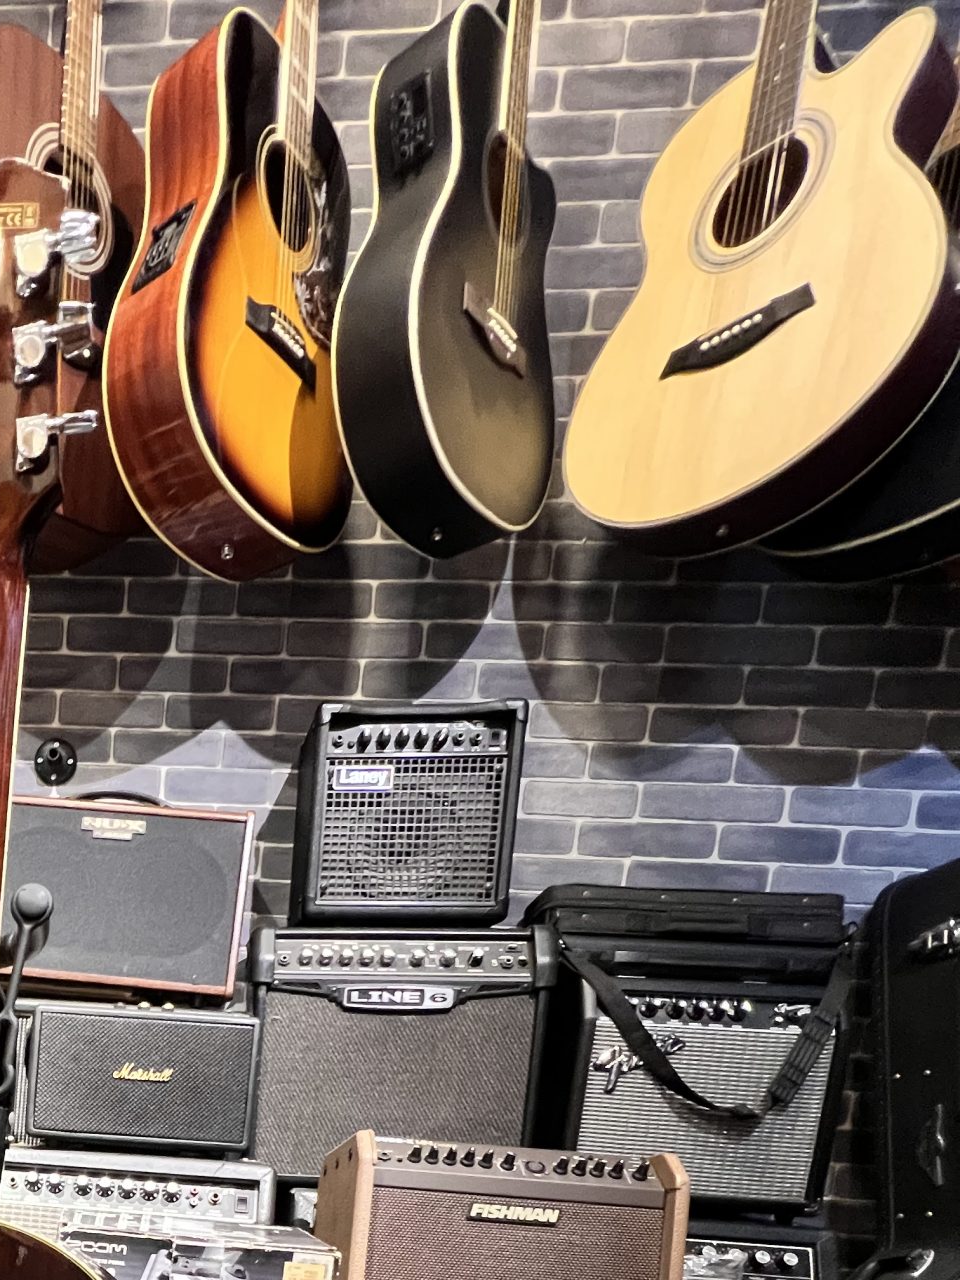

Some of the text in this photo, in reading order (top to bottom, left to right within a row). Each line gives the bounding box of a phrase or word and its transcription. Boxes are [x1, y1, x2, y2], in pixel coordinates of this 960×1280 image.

[339, 769, 388, 787] Laney
[351, 990, 422, 1004] LINE
[112, 1062, 174, 1082] Marshall
[469, 1203, 560, 1223] FISHMAN
